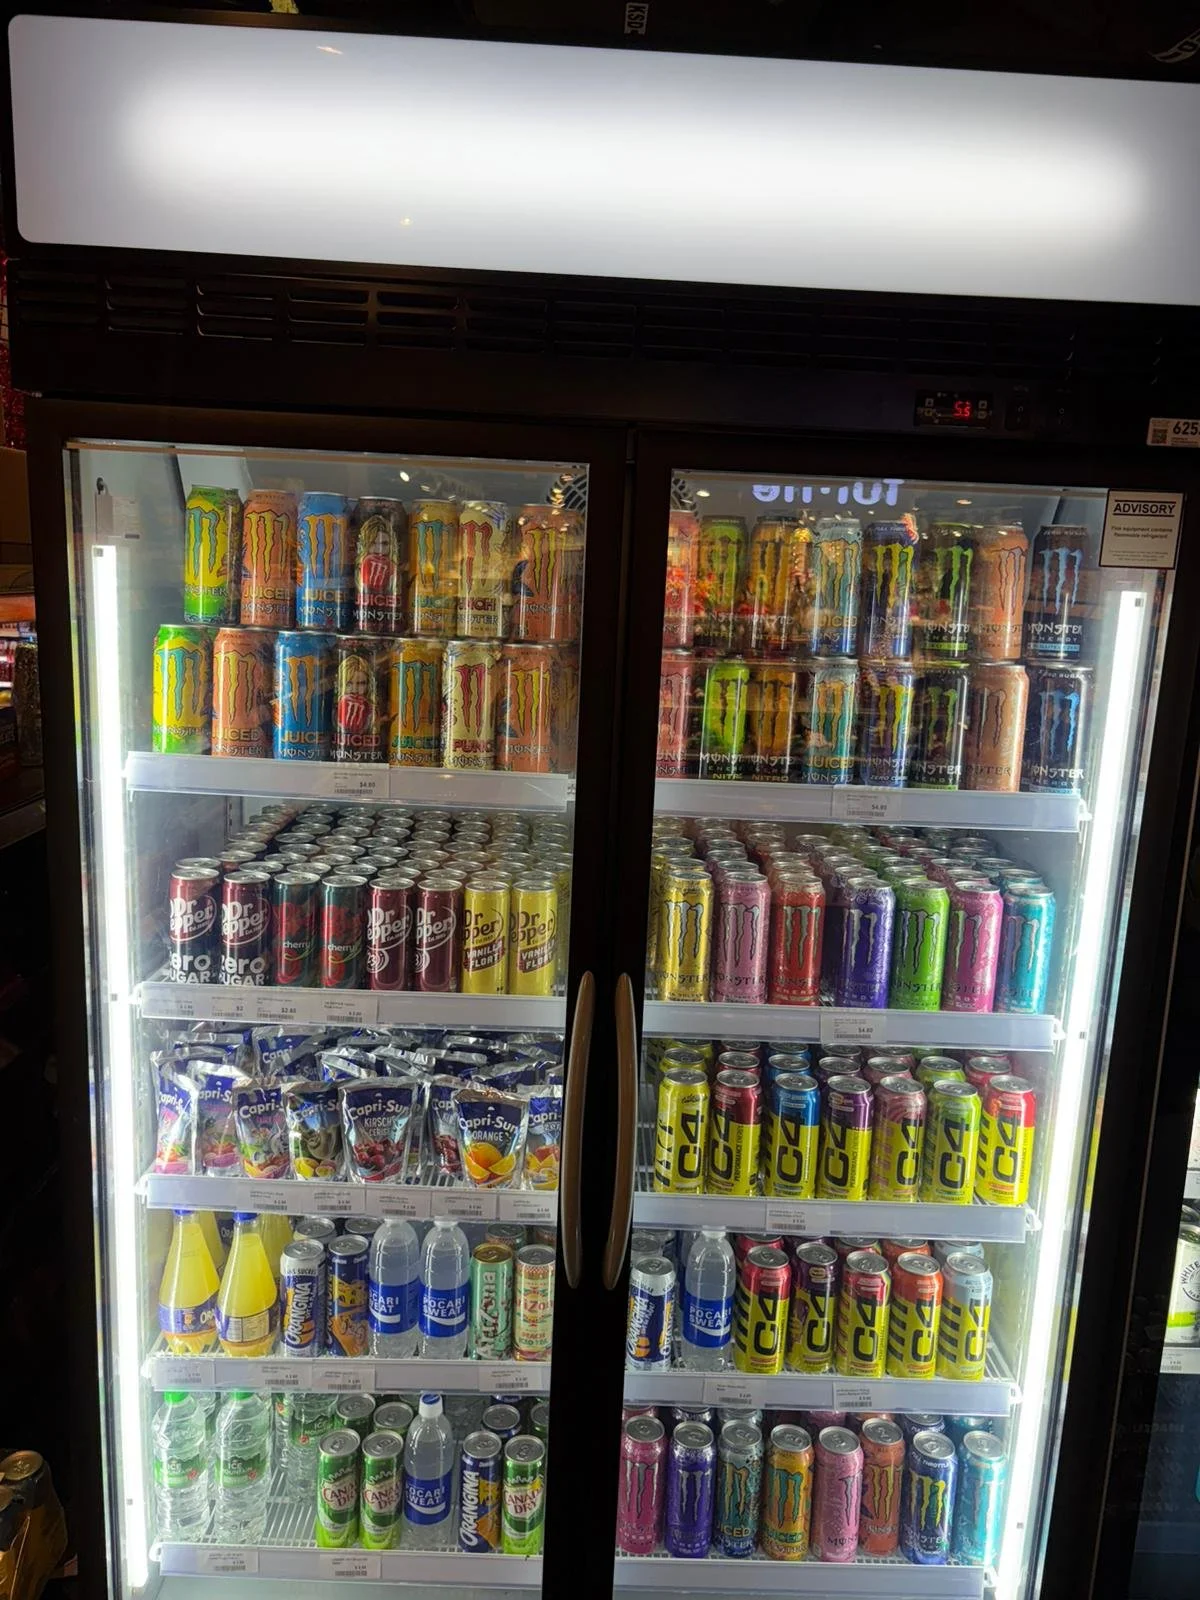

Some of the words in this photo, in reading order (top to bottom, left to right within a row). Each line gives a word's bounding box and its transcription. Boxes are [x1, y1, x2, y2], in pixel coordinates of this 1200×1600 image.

[1173, 420, 1200, 435] 625
[1113, 503, 1176, 514] ADVISORY
[349, 1099, 411, 1121] Capri-Sun
[364, 1117, 393, 1129] KIRSCH
[459, 1113, 519, 1134] Capri-Sun
[472, 1130, 503, 1142] ORANGE
[678, 1110, 704, 1179] C4
[710, 1110, 734, 1181] C4
[777, 1111, 804, 1184] C4
[824, 1114, 849, 1187] C4
[896, 1117, 924, 1186] C4
[939, 1118, 969, 1189] C4
[993, 1114, 1017, 1183] C4
[284, 1281, 313, 1345] ORANGINA
[422, 1295, 466, 1309] POCARI
[689, 1305, 732, 1320] POCARI
[754, 1290, 779, 1356] C4
[807, 1290, 832, 1353] C4
[854, 1294, 878, 1362] C4
[911, 1294, 936, 1363] C4
[965, 1297, 990, 1363] C4
[459, 1469, 480, 1548] ORANGINA
